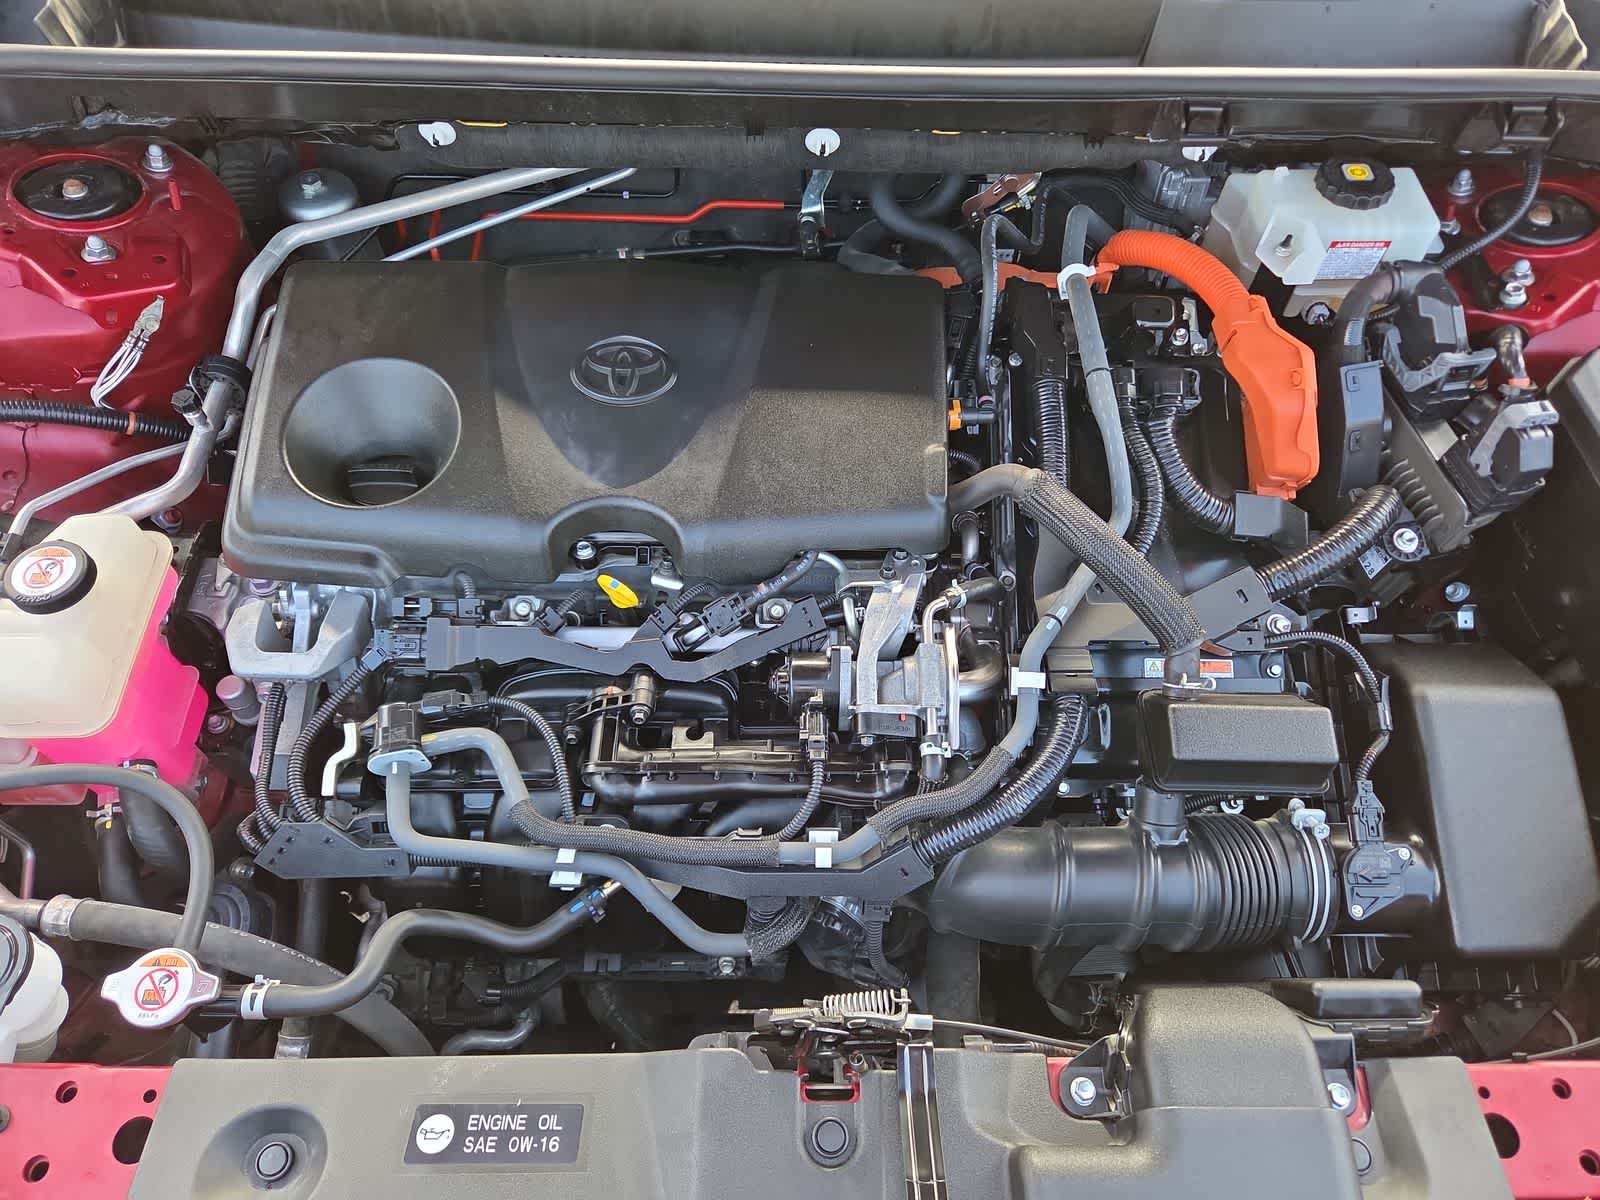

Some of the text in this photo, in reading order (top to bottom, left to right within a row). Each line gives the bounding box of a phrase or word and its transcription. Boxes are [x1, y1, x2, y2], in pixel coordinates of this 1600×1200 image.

[467, 1114, 563, 1131] ENGINE OIL
[463, 1136, 561, 1153] SAE 0W-16
